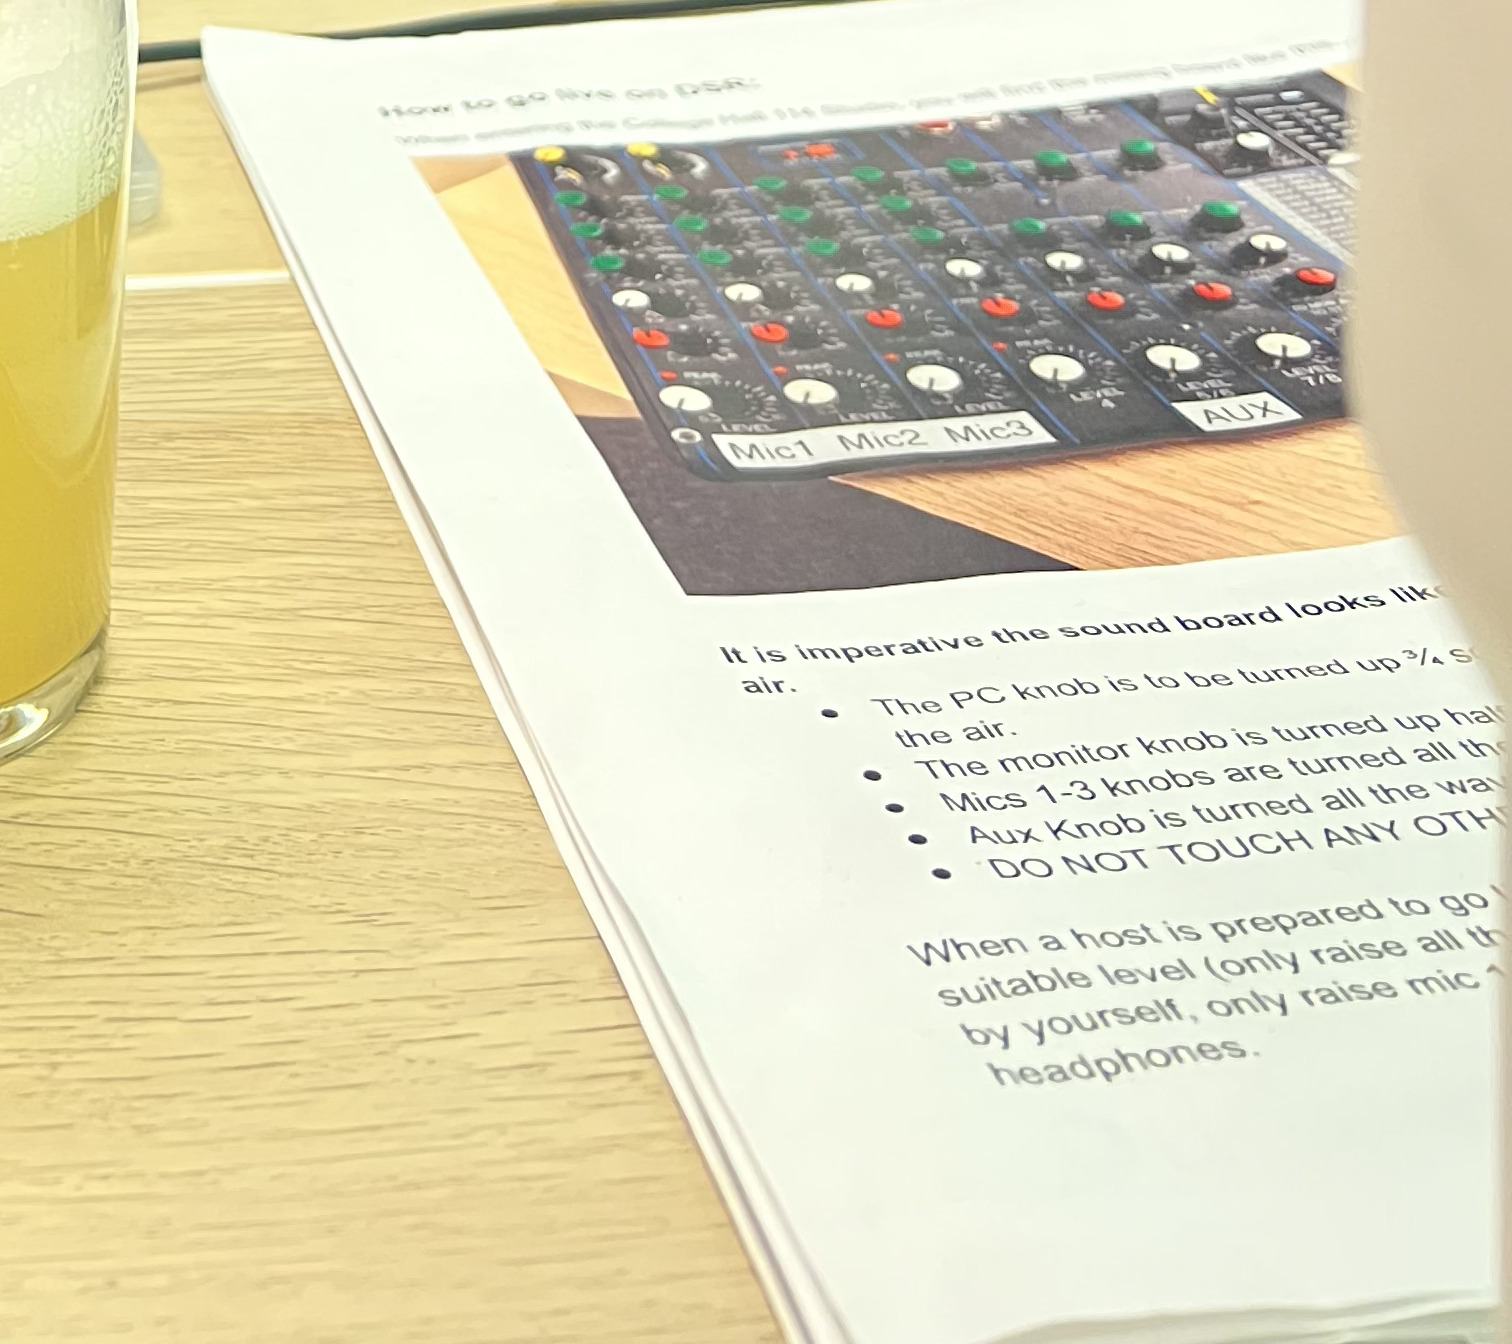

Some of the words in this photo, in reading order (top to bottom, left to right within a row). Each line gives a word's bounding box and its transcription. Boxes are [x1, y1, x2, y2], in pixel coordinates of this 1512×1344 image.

[728, 439, 814, 461] Mic1
[837, 429, 928, 452] Mic2
[943, 420, 1033, 444] Mic3
[1203, 401, 1284, 424] AUX
[719, 646, 748, 664] It
[753, 646, 787, 663] is
[794, 635, 984, 663] imperative
[991, 628, 1050, 644] the
[1058, 617, 1171, 638] sound
[1173, 605, 1284, 631] board
[1285, 593, 1386, 619] looks
[741, 676, 797, 694] air.
[870, 698, 943, 716] The
[949, 686, 1006, 709] PC
[1011, 677, 1101, 700] knob
[1104, 675, 1139, 692] is
[1143, 673, 1181, 689] to
[1184, 671, 1234, 688] be
[1237, 658, 1350, 684] turned
[1356, 655, 1402, 674] up
[895, 729, 952, 748] the
[962, 720, 1017, 741] air.
[914, 759, 990, 779] The
[998, 743, 1130, 774] monitor
[1136, 730, 1228, 755] knob
[1231, 728, 1268, 746] is
[1271, 714, 1388, 743] turned
[1394, 713, 1441, 732] up
[939, 792, 1027, 812] Mics
[1036, 780, 1096, 804] 1-3
[1100, 769, 1216, 797] knobs
[1223, 764, 1283, 783] are
[1287, 746, 1407, 776] turned
[1412, 740, 1457, 762] all
[969, 825, 1044, 844] Aux
[1044, 813, 1146, 841] Knob
[1149, 809, 1187, 829] is
[1192, 793, 1314, 824] turned
[1320, 787, 1366, 811] all
[1367, 783, 1431, 805] the
[987, 857, 1054, 879] DO
[1061, 848, 1149, 875] NOT
[1156, 829, 1314, 865] TOUCH
[1324, 819, 1401, 849] ANY
[906, 936, 1029, 967] When
[1038, 934, 1067, 951] a
[1070, 923, 1163, 950] host
[1162, 920, 1202, 942] is
[1210, 898, 1384, 943] prepared
[1388, 896, 1431, 916] to
[1439, 892, 1489, 917] go
[938, 967, 1093, 1008] suitable
[1097, 958, 1196, 986] level
[1203, 948, 1300, 983] (only
[1310, 939, 1408, 965] raise
[1416, 928, 1464, 953] all
[1465, 925, 1509, 949] th
[959, 1023, 1010, 1050] by
[1021, 998, 1200, 1046] yourself,
[1206, 989, 1288, 1017] only
[1298, 980, 1399, 1007] raise
[1405, 968, 1481, 996] mic
[986, 1039, 1263, 1087] headphones.
